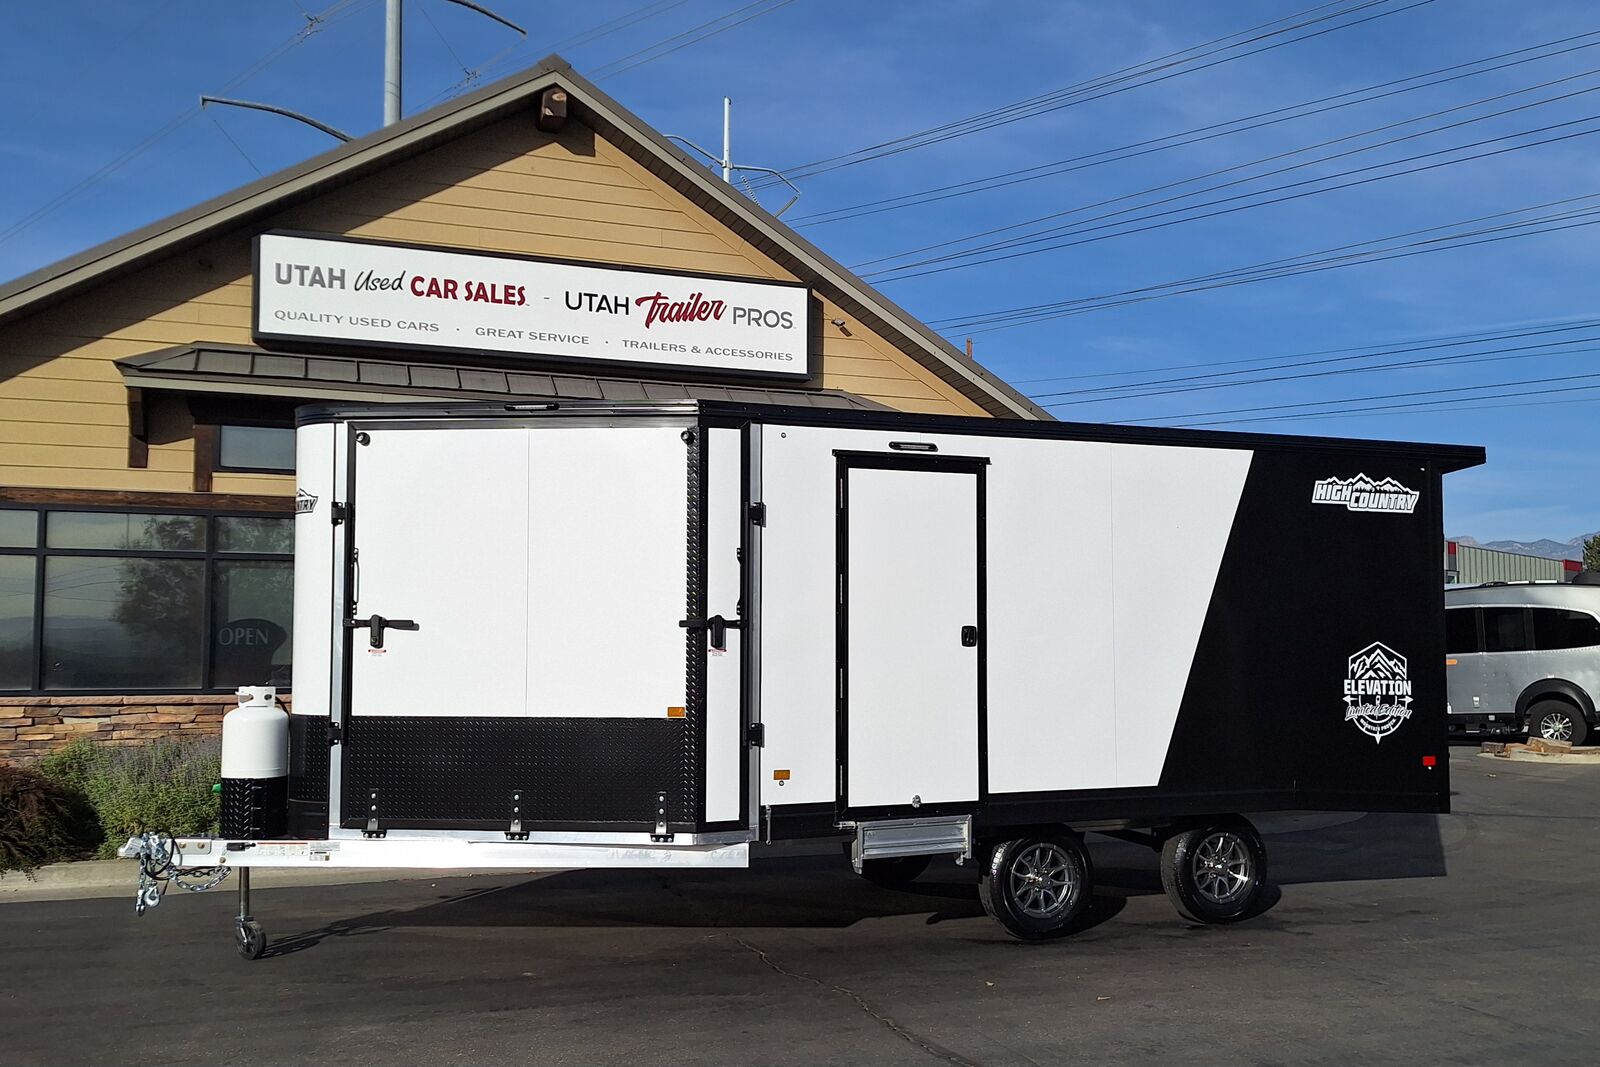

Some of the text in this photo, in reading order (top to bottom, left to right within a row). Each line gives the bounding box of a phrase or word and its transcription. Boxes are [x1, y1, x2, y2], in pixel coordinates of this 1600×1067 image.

[275, 262, 793, 330] UTAH Used CAR SALES UTAH Trailer PROS
[274, 309, 793, 361] QUALITY USED CARS GREAT SERVICE TRAILERS & ACCESSORIES
[1315, 484, 1353, 501] HIGH
[1349, 491, 1416, 510] COUNTRY
[219, 627, 269, 646] OPEN
[1343, 679, 1412, 696] ELEVATION
